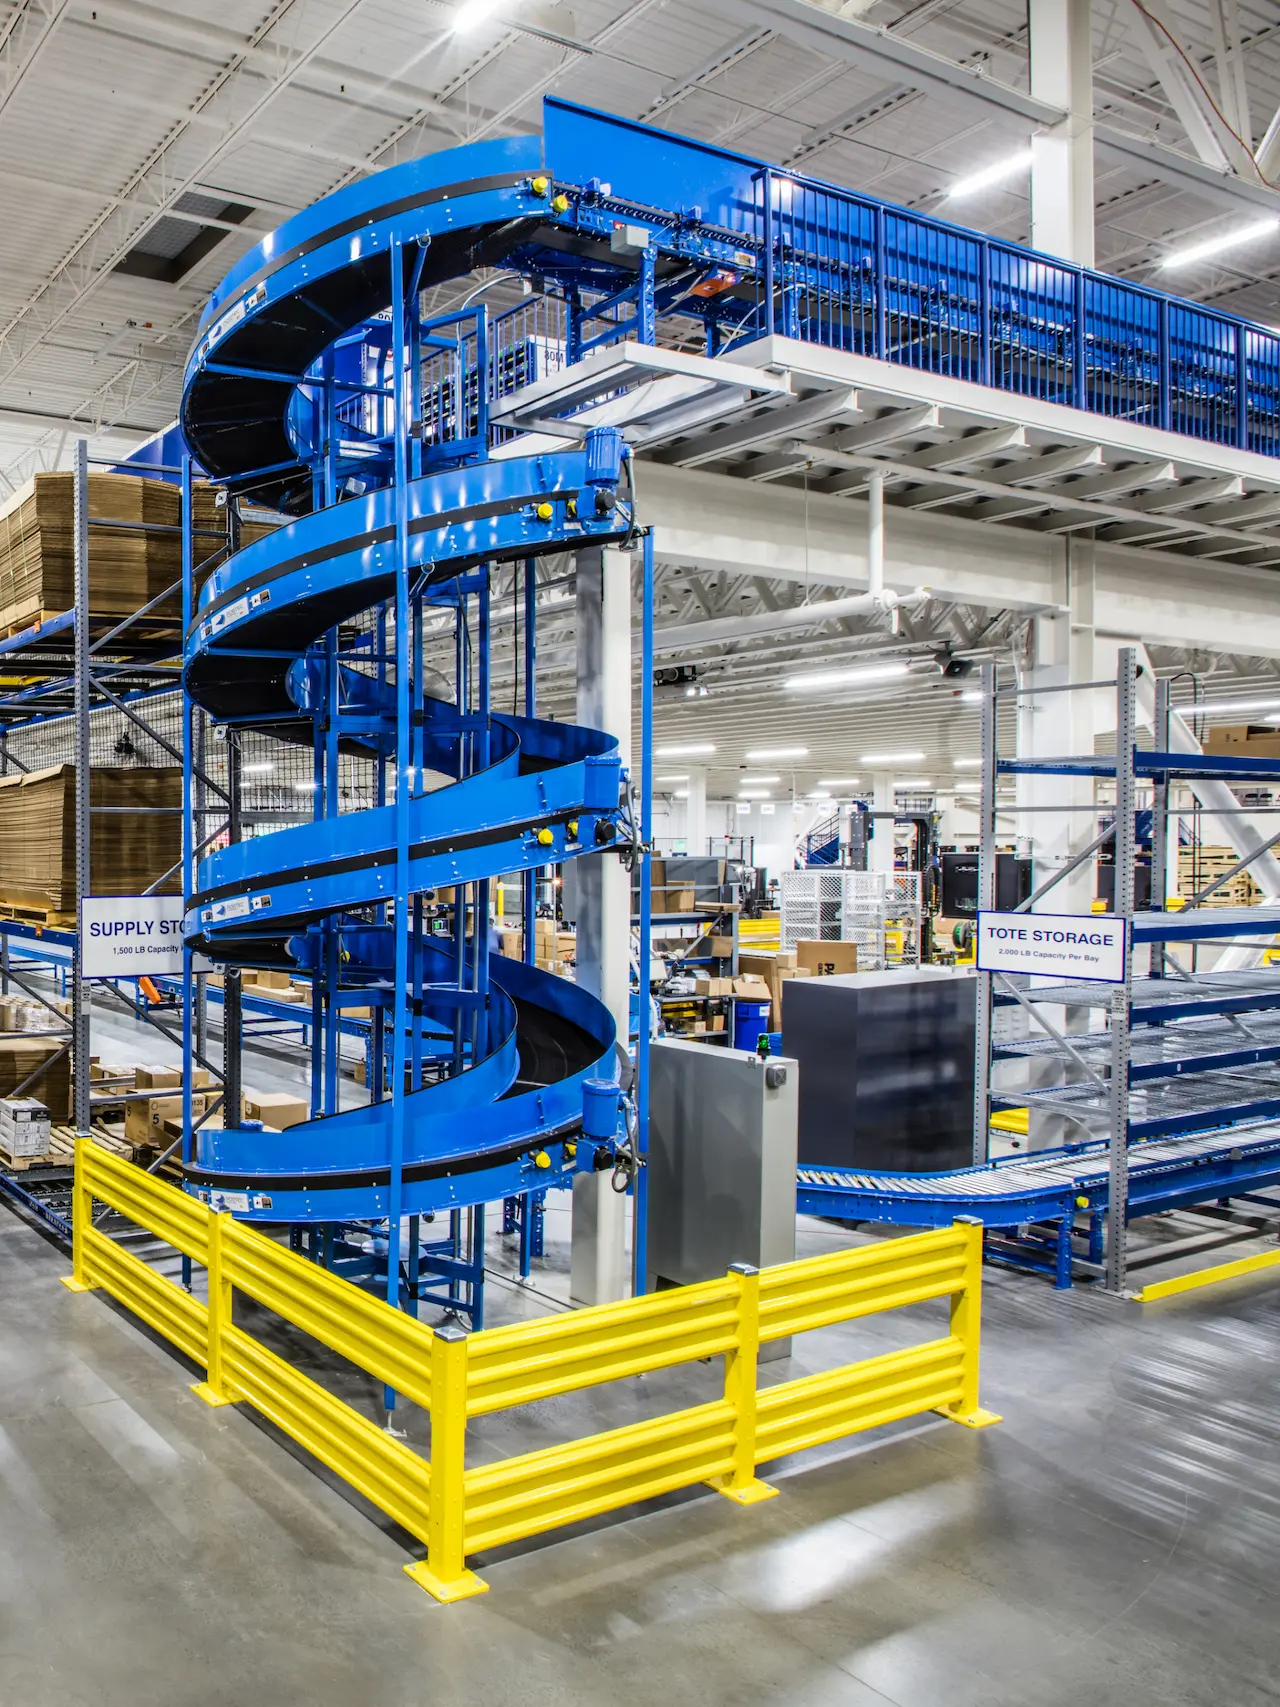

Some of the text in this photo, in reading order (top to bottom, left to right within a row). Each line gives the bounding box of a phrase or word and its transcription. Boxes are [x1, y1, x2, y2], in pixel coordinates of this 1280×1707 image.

[90, 921, 154, 937] SUPPLY
[987, 927, 1114, 946] TOTE STORAGE
[113, 947, 133, 955] 1,500
[147, 945, 179, 954] Capacity
[1033, 951, 1066, 960] Capacity
[1084, 955, 1099, 963] Bay
[152, 1114, 159, 1124] 5
